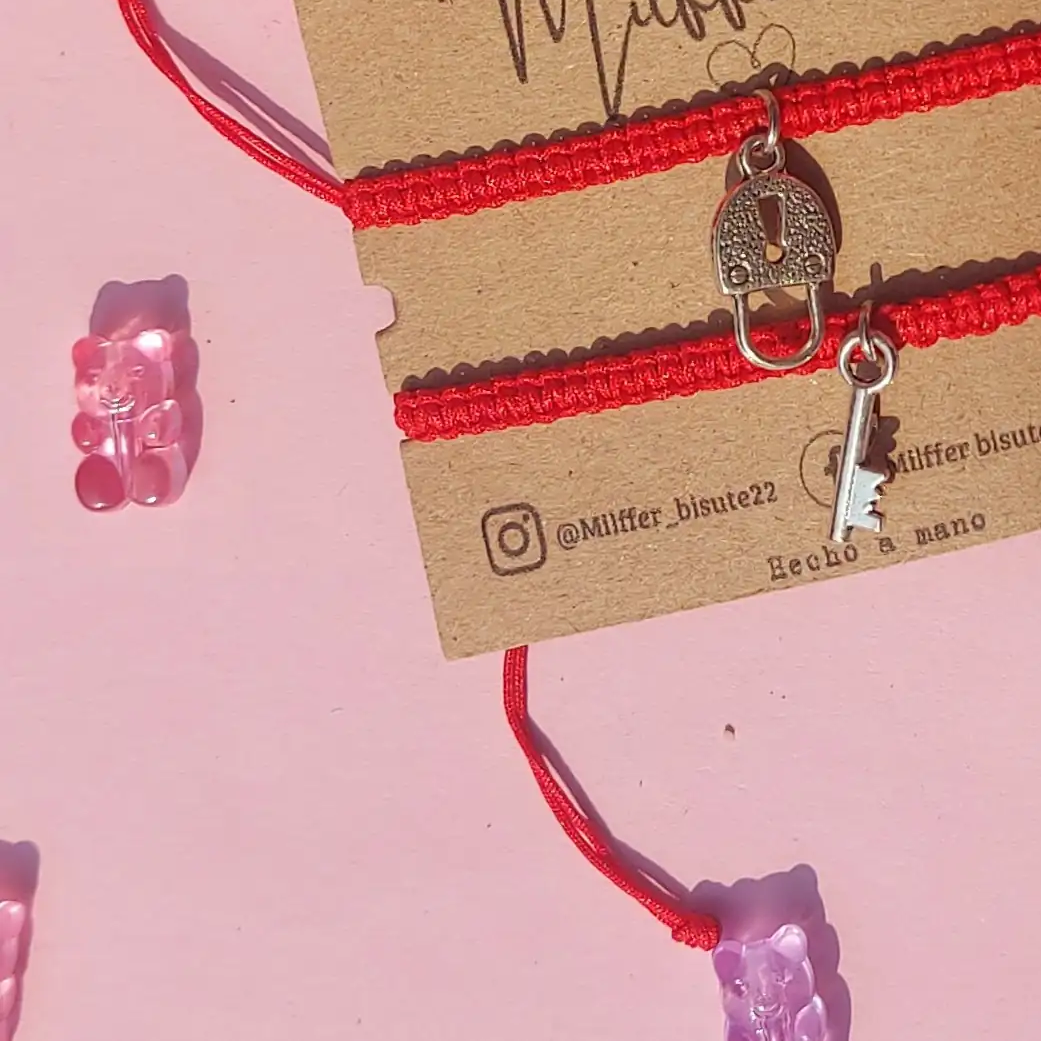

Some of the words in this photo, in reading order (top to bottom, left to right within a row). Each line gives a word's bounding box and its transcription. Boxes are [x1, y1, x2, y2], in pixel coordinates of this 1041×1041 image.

[556, 480, 778, 551] @Milffer_bisute22
[767, 543, 859, 582] Hecho
[877, 535, 896, 555] a
[914, 512, 986, 545] mano
